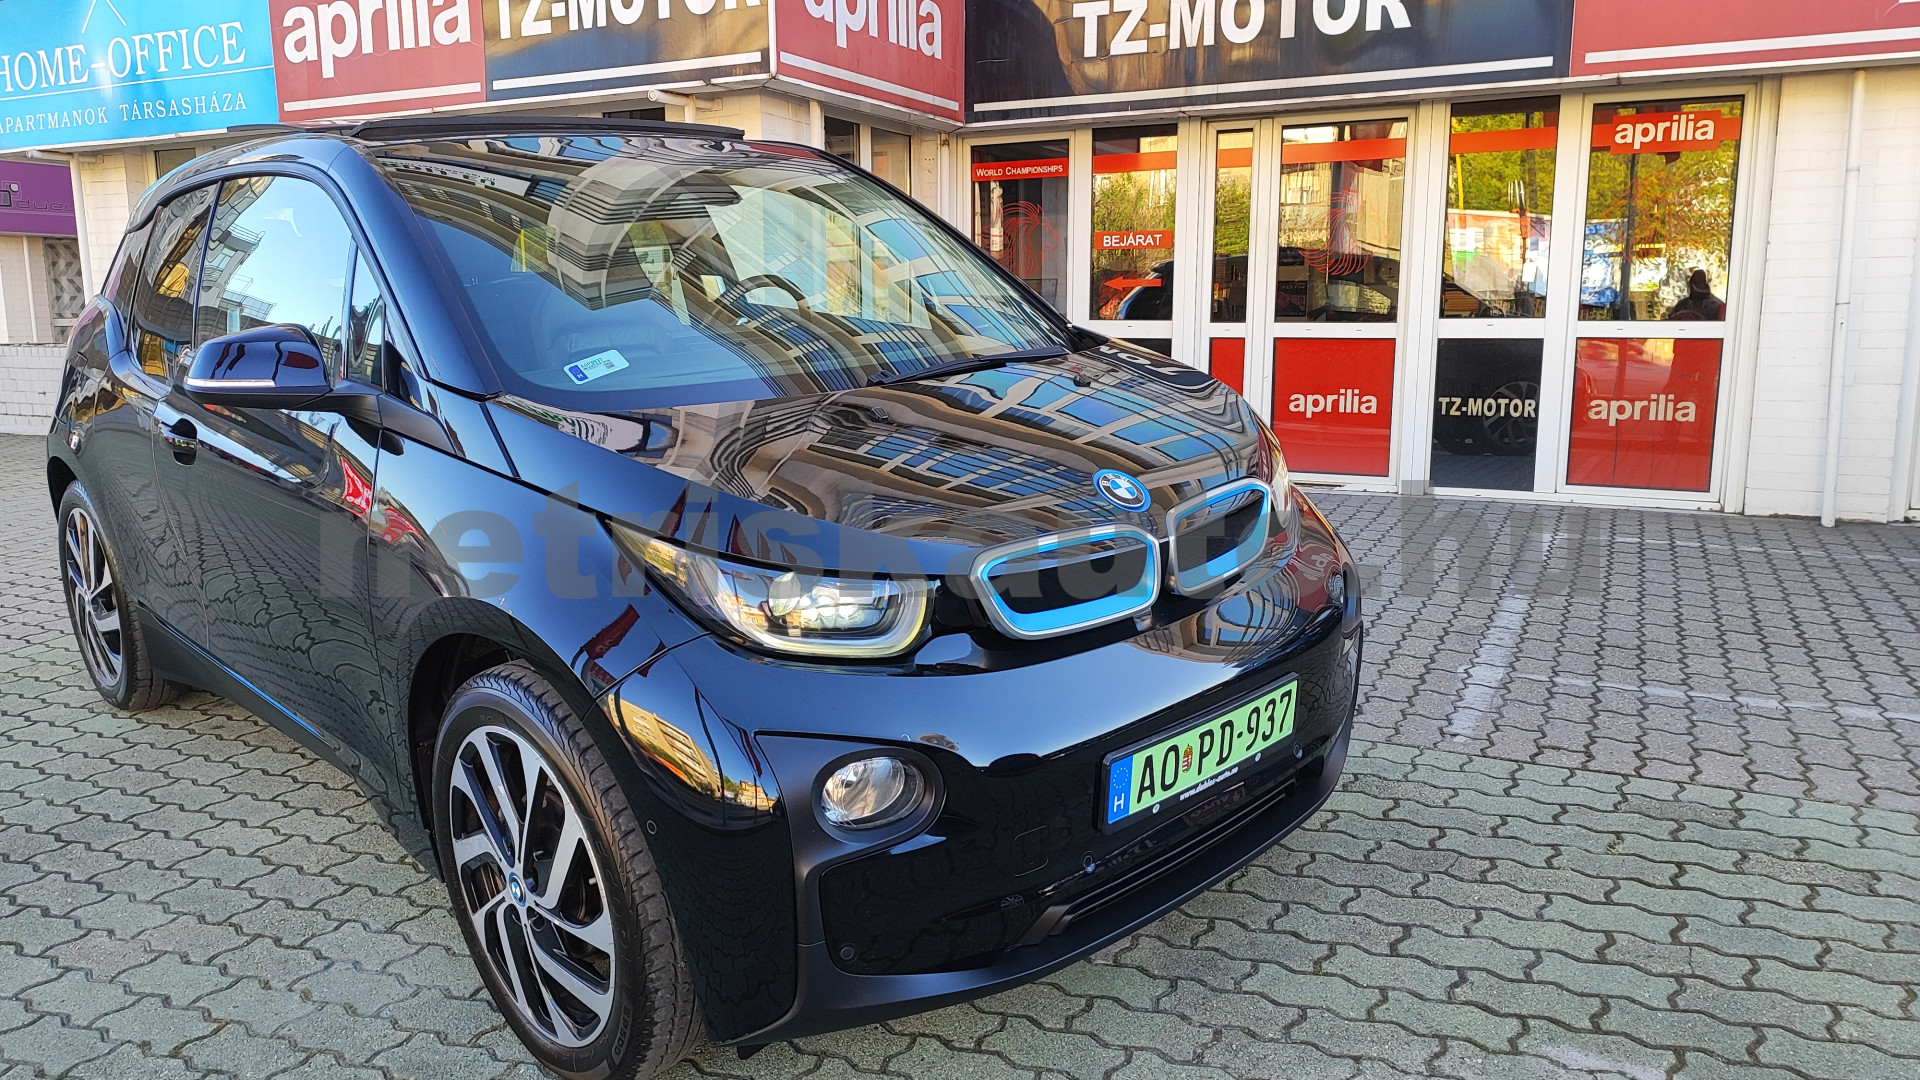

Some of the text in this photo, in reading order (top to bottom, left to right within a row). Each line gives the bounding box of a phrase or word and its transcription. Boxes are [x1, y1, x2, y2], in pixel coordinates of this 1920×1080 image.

[120, 91, 247, 121] TÁRSASHÁZA
[1614, 114, 1715, 149] aprilia
[1103, 231, 1163, 247] BEJÁRAT
[1289, 389, 1377, 418] aprilia
[1438, 397, 1536, 418] TZ-MOTOR
[1588, 394, 1697, 427] aprilia
[1114, 793, 1124, 813] H
